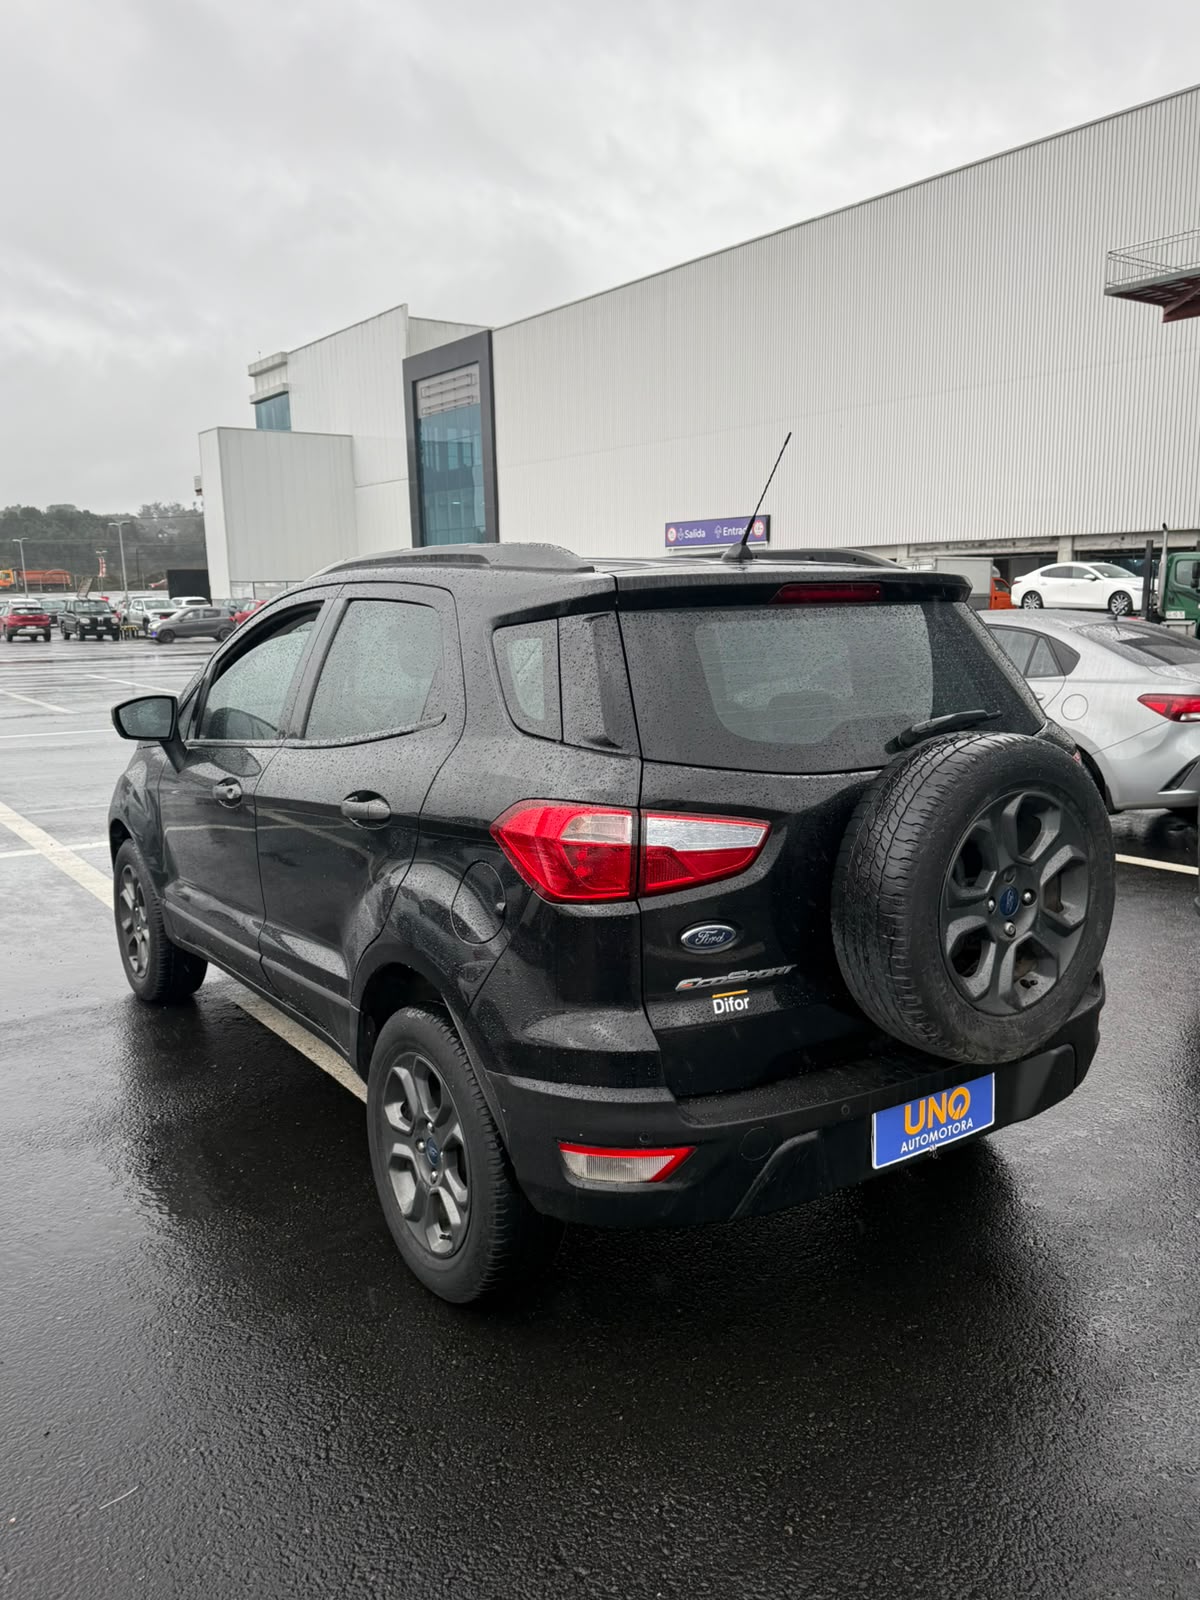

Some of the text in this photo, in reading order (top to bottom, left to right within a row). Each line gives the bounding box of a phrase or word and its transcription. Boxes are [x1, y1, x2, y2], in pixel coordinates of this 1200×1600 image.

[684, 524, 752, 539] Salida Entrad
[695, 930, 726, 945] Ford
[712, 997, 750, 1014] Difor
[904, 1086, 971, 1135] UNO
[900, 1117, 973, 1154] AUTOMOTORA
